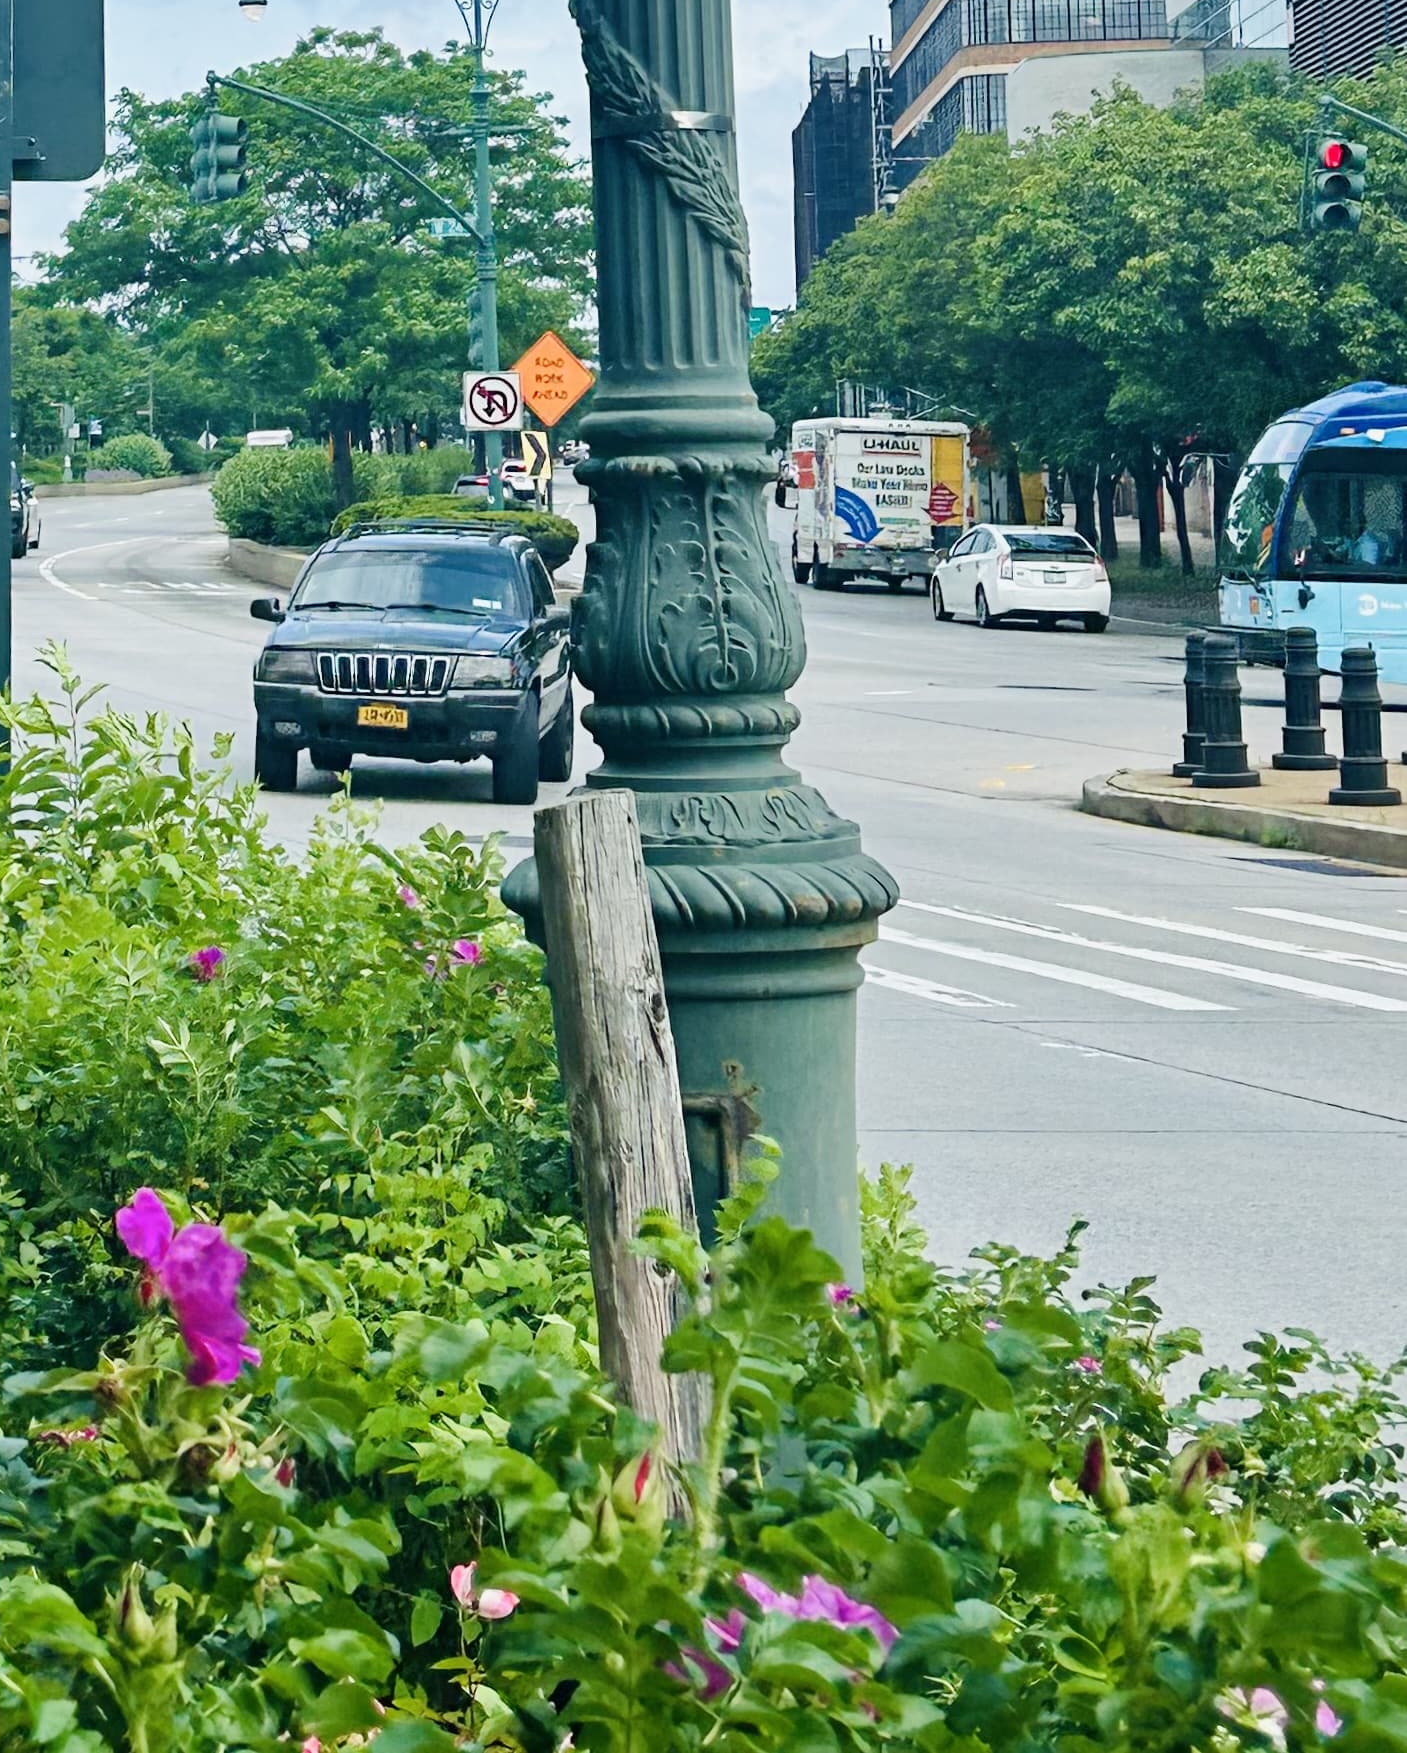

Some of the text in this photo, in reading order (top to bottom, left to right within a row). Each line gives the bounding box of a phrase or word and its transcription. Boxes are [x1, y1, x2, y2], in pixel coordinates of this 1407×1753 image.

[535, 357, 565, 368] ROAD
[535, 373, 564, 384] WORK
[532, 390, 568, 400] AHEAD
[863, 439, 920, 451] U-HAUL
